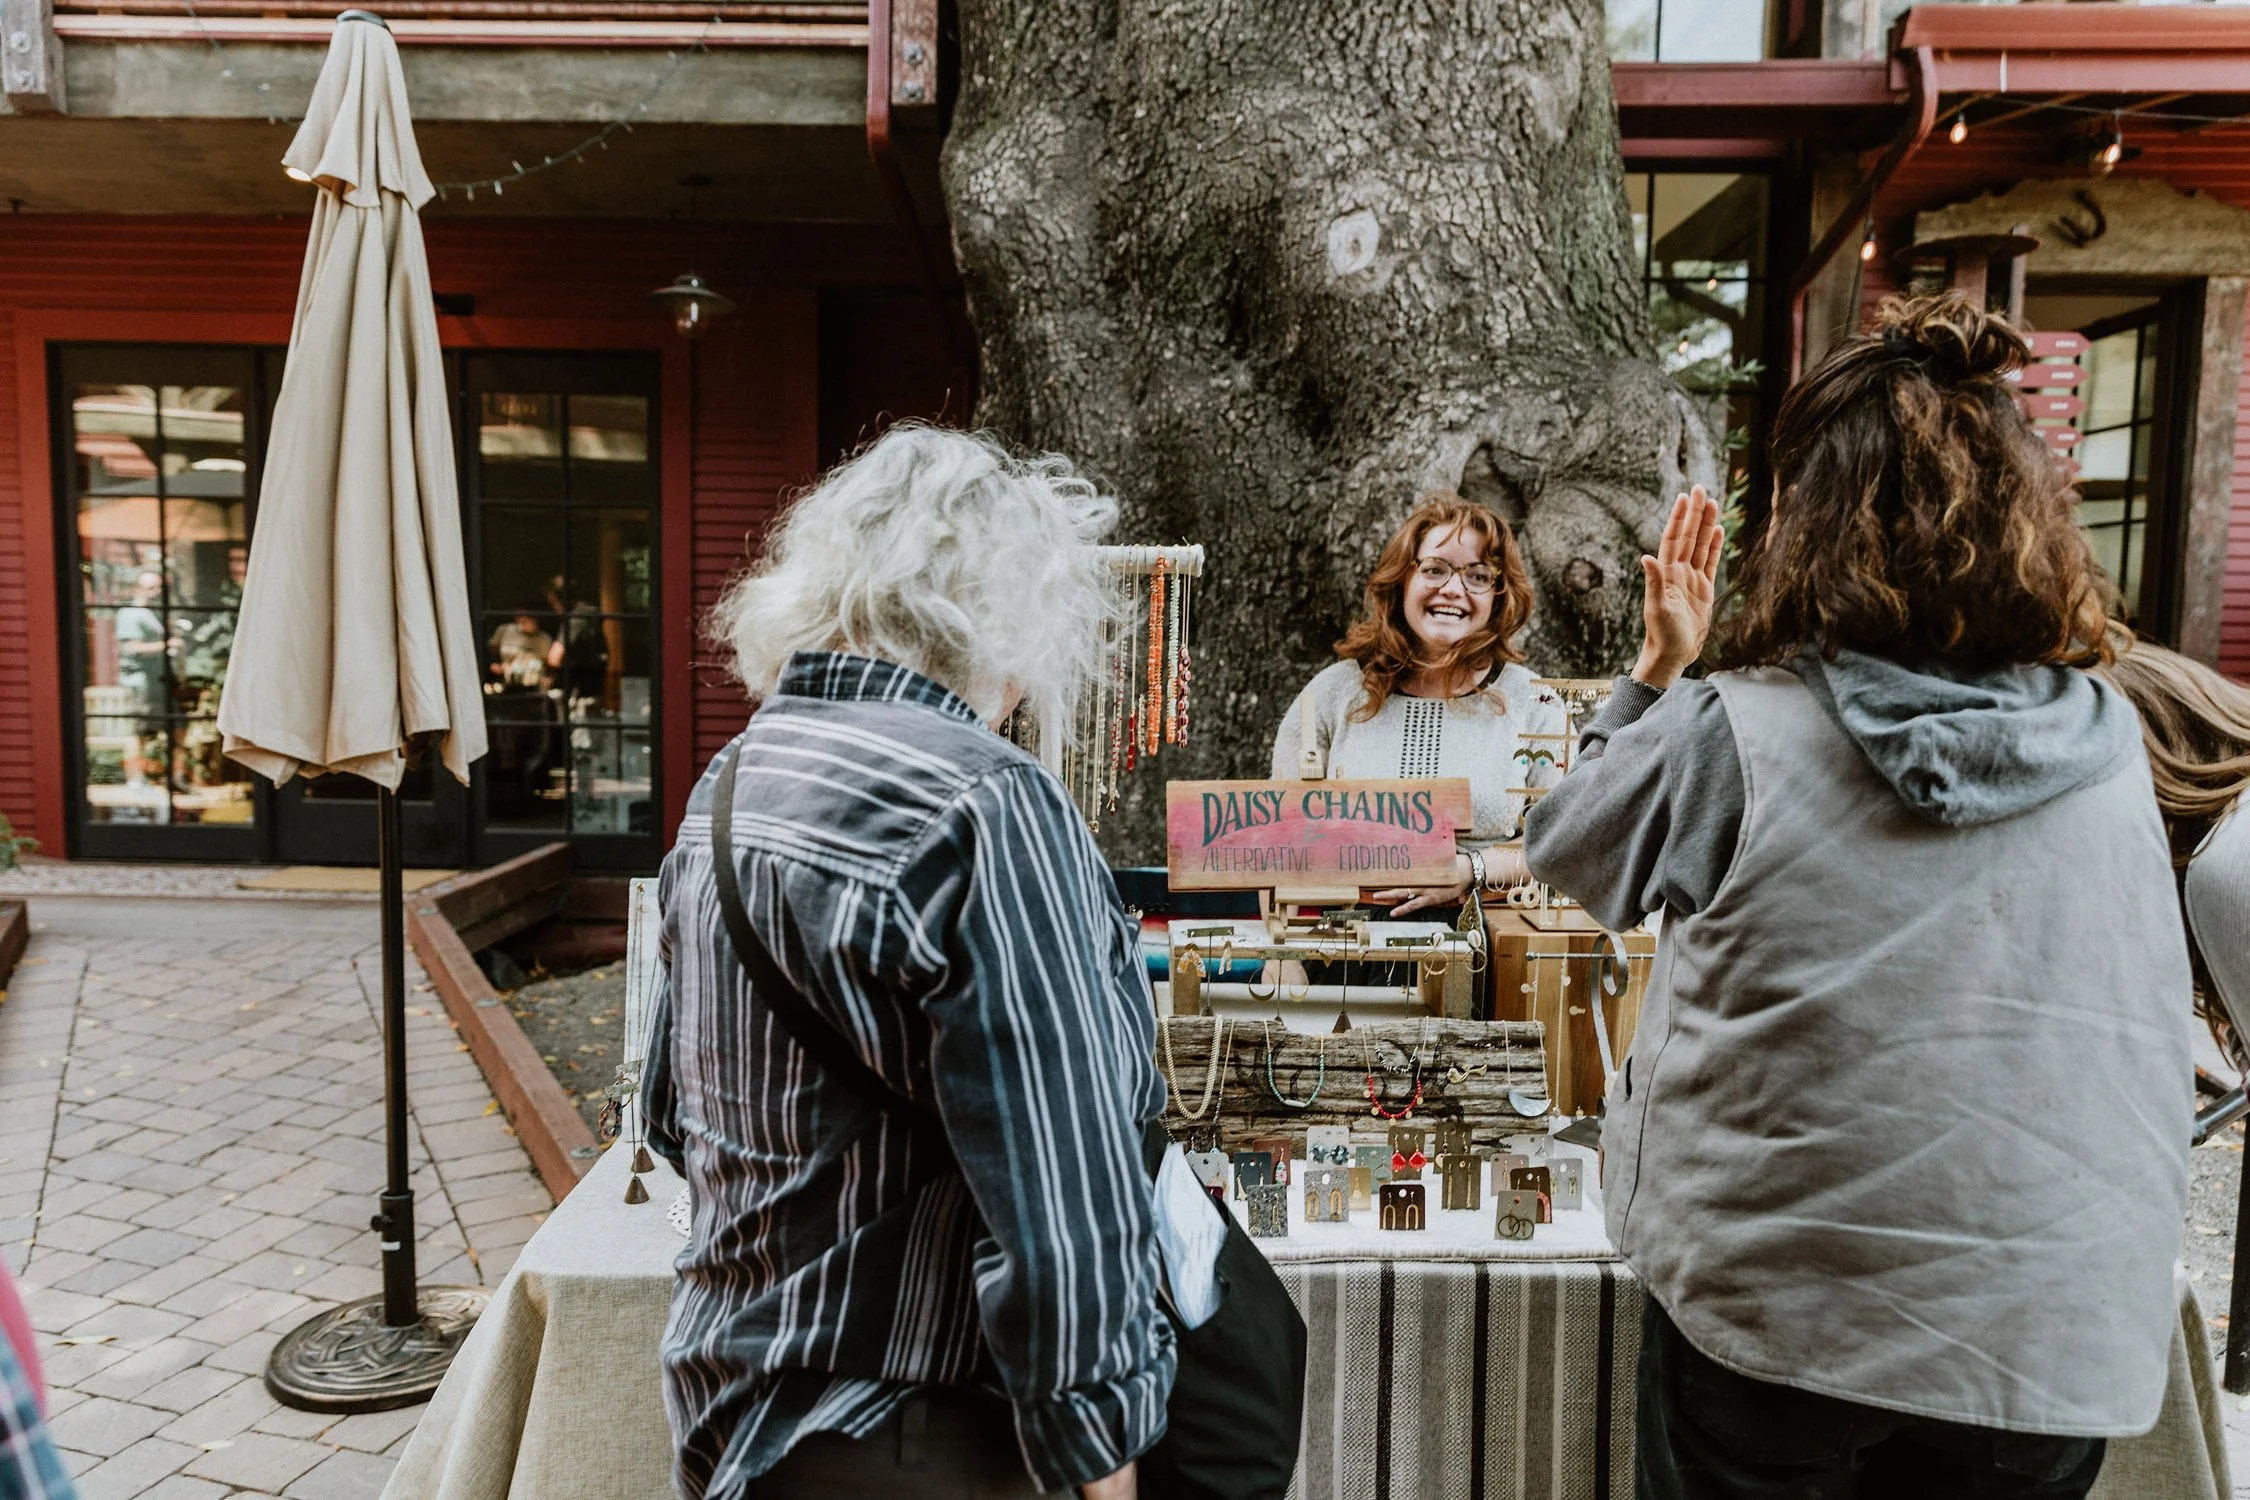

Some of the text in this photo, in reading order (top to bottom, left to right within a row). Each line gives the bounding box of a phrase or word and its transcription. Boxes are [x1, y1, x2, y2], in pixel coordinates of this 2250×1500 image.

[1201, 790, 1433, 847] DAISY CHAINS
[1202, 843, 1313, 873] ALTERNATIVE
